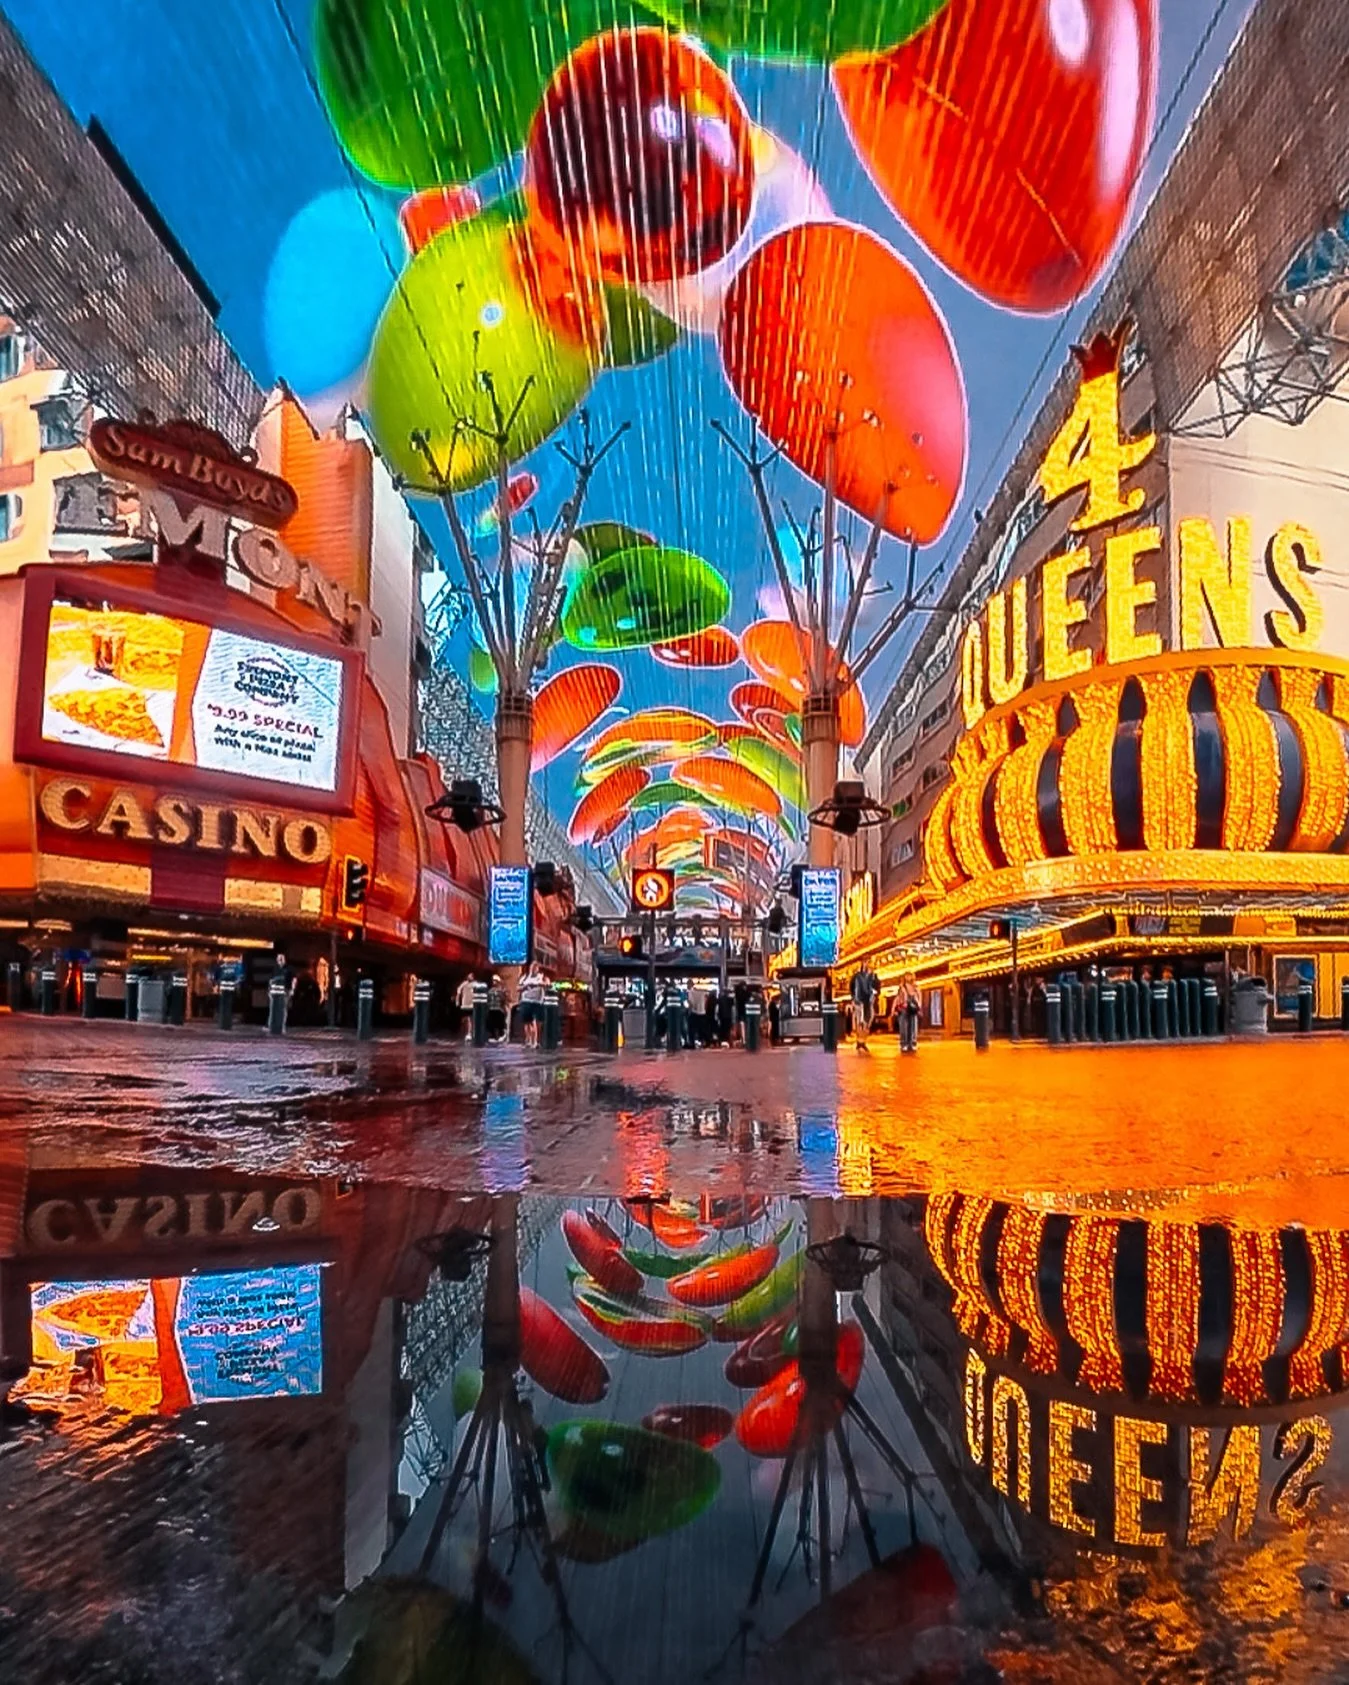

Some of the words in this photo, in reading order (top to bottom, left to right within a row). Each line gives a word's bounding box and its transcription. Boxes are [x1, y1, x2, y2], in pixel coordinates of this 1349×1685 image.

[102, 424, 182, 475] Sam
[1039, 368, 1156, 532] 4
[960, 514, 1324, 730] QUEENS
[253, 713, 324, 739] SPECIAL
[40, 776, 332, 864] CASINO
